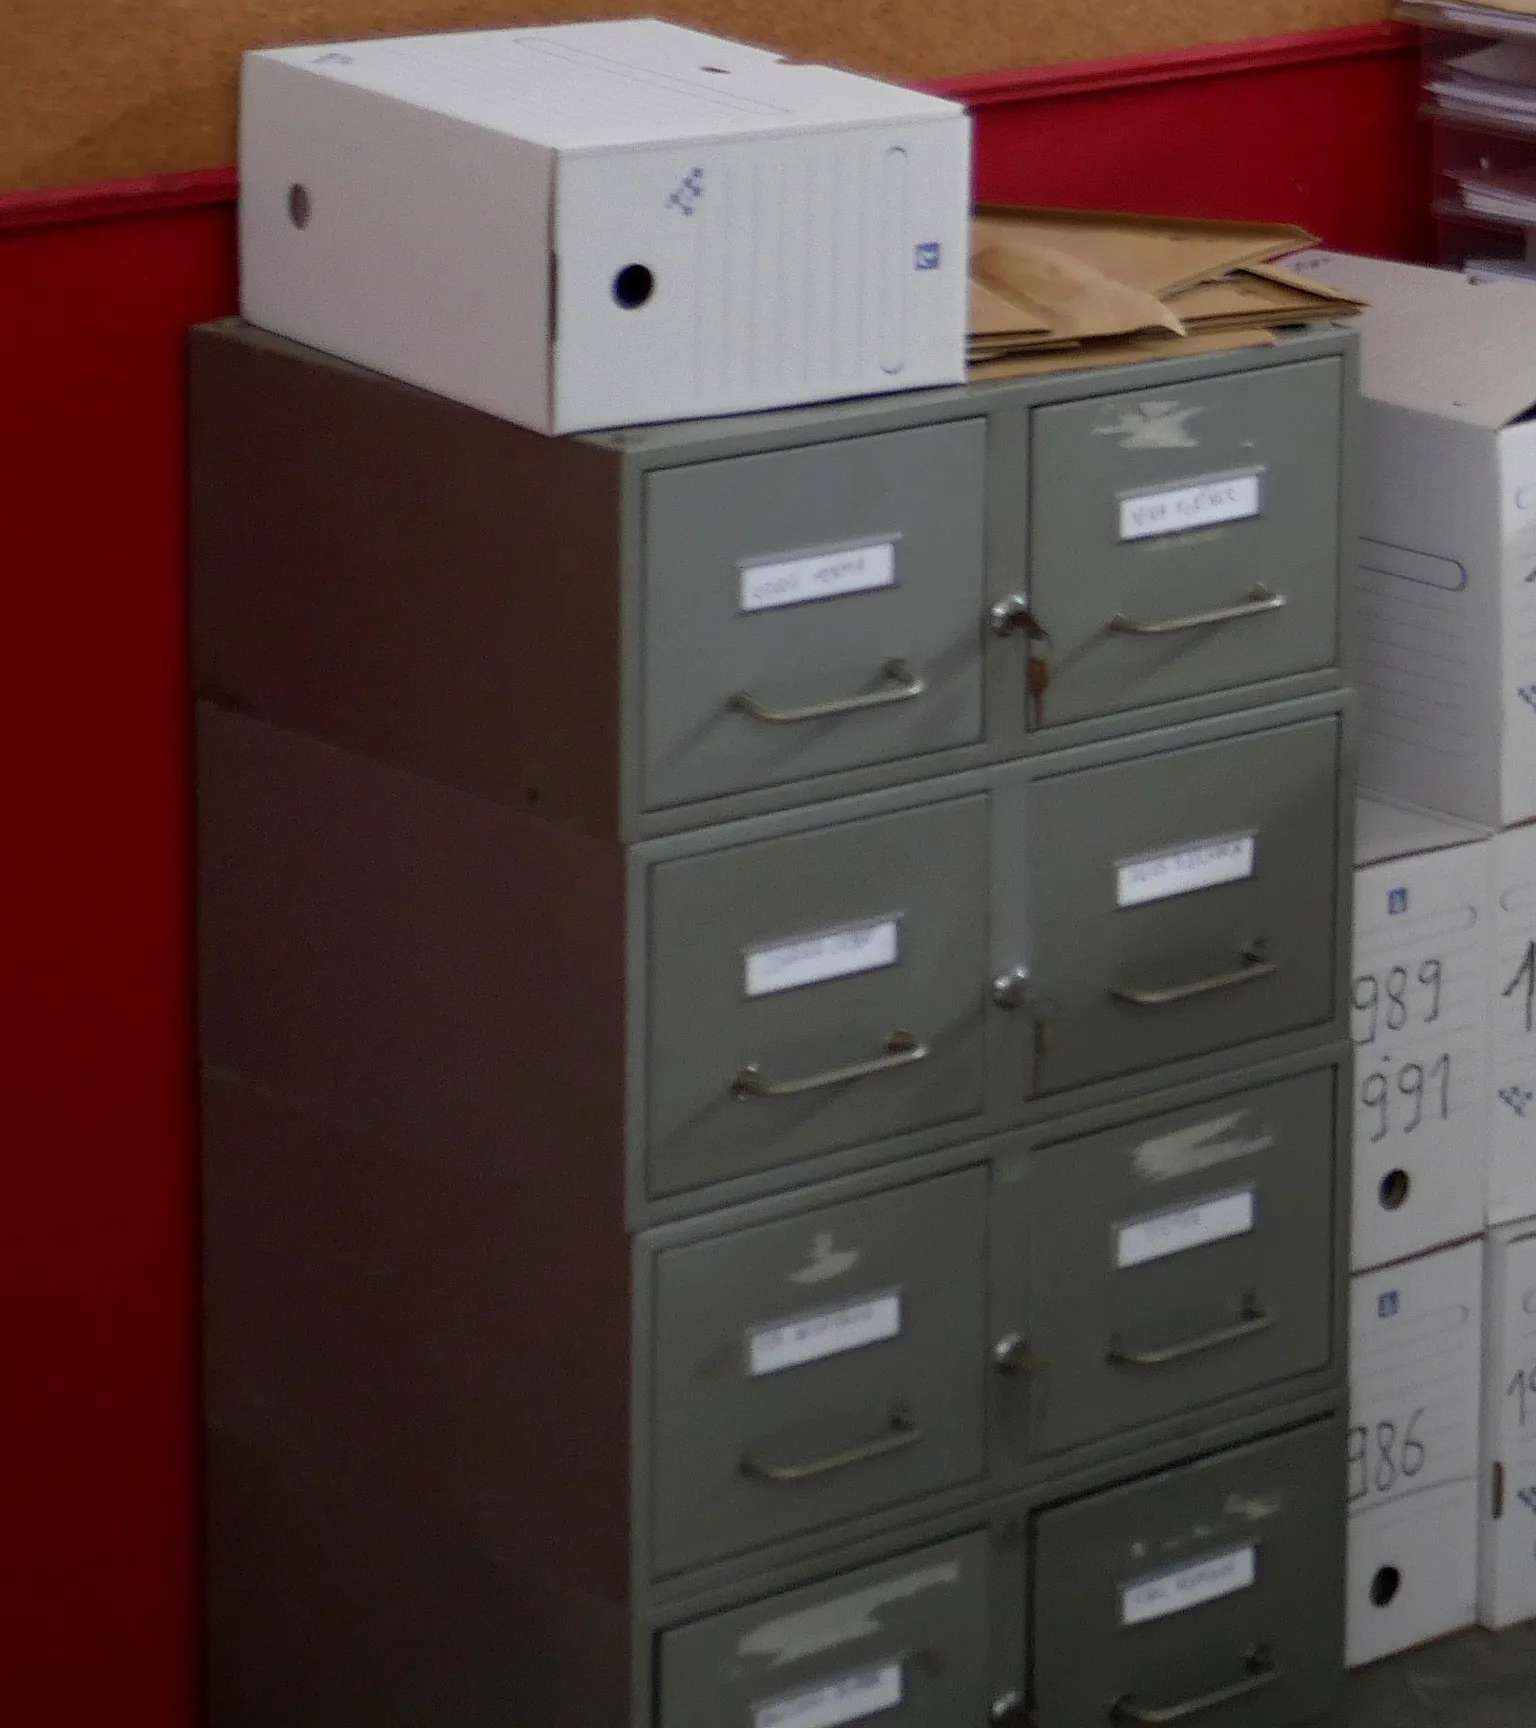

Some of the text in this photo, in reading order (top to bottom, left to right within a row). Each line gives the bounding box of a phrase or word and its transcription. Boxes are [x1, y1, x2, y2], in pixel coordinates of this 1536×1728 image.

[1352, 958, 1443, 1046] 989
[1361, 1052, 1451, 1144] 991
[1346, 1405, 1427, 1505] 986
